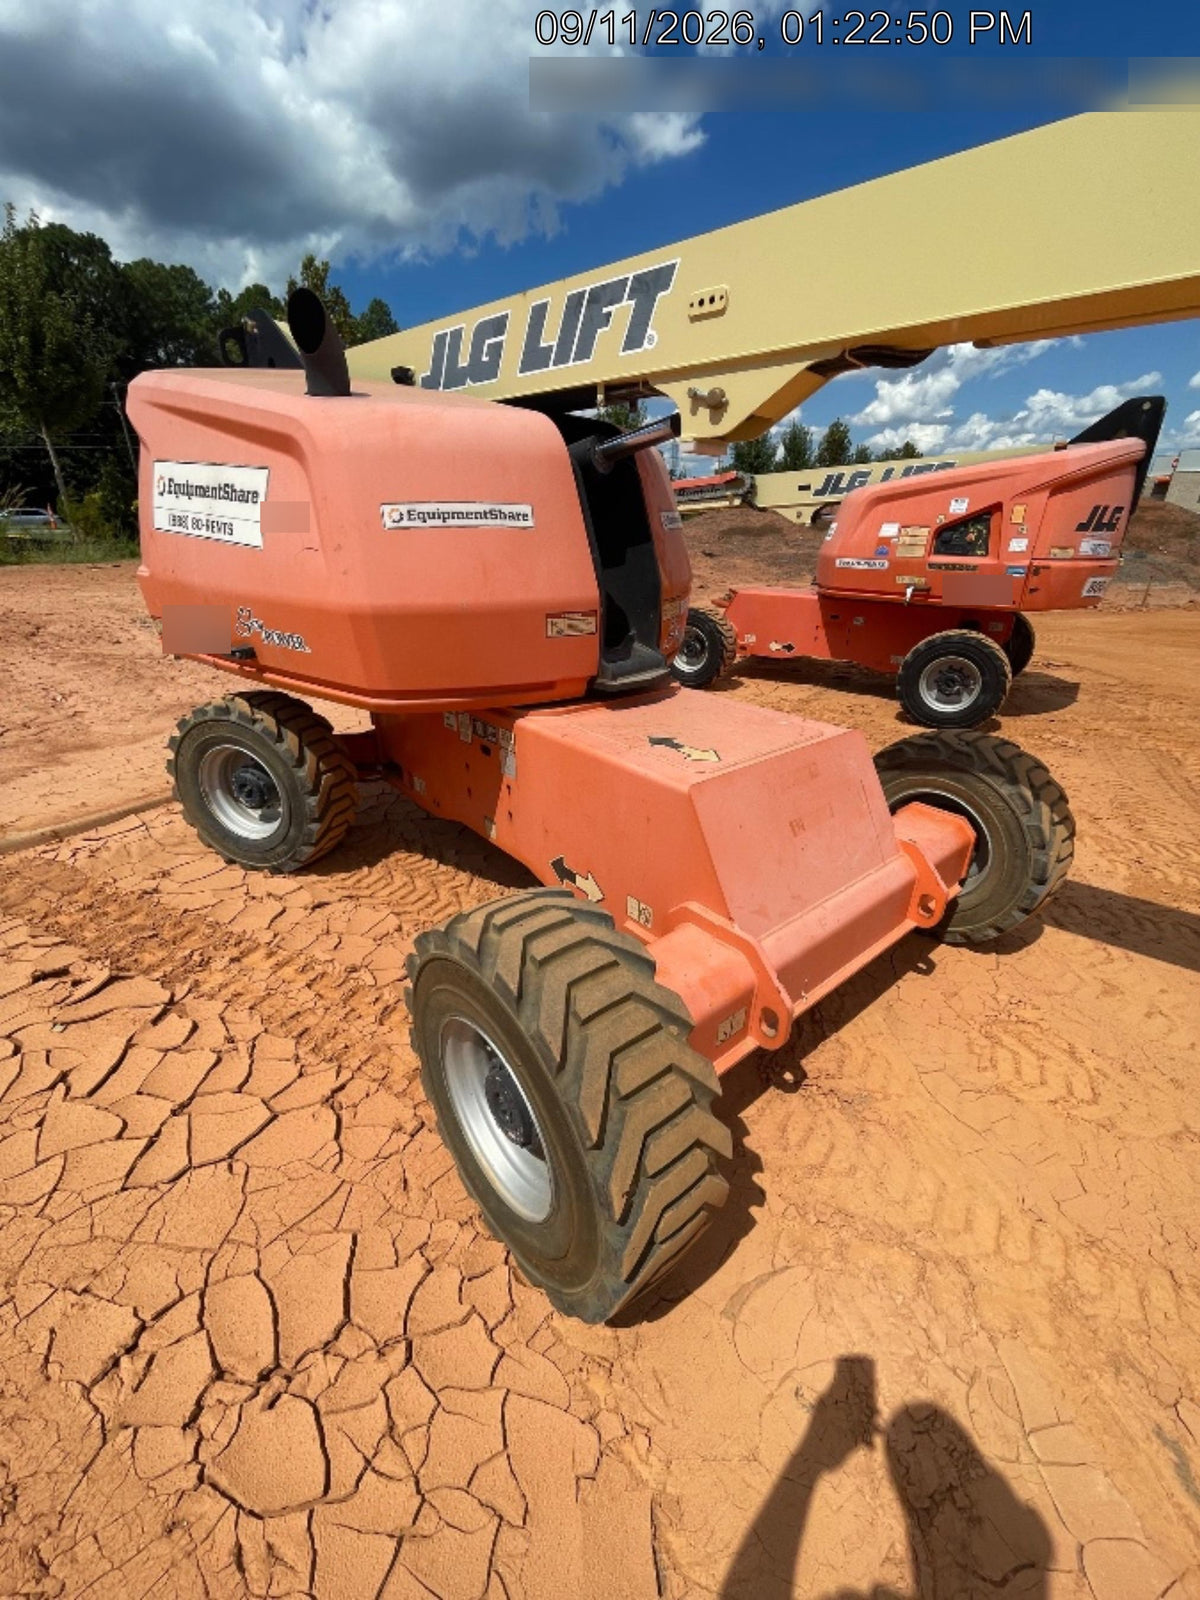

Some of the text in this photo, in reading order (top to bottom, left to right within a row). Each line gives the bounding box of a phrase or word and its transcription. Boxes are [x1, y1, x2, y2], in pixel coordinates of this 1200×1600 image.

[419, 258, 681, 391] JLG LIFT
[167, 477, 259, 504] EquipmentShare
[191, 516, 234, 536] 80-RENTS
[406, 507, 529, 523] EquipmentShare
[1075, 504, 1125, 532] JLG
